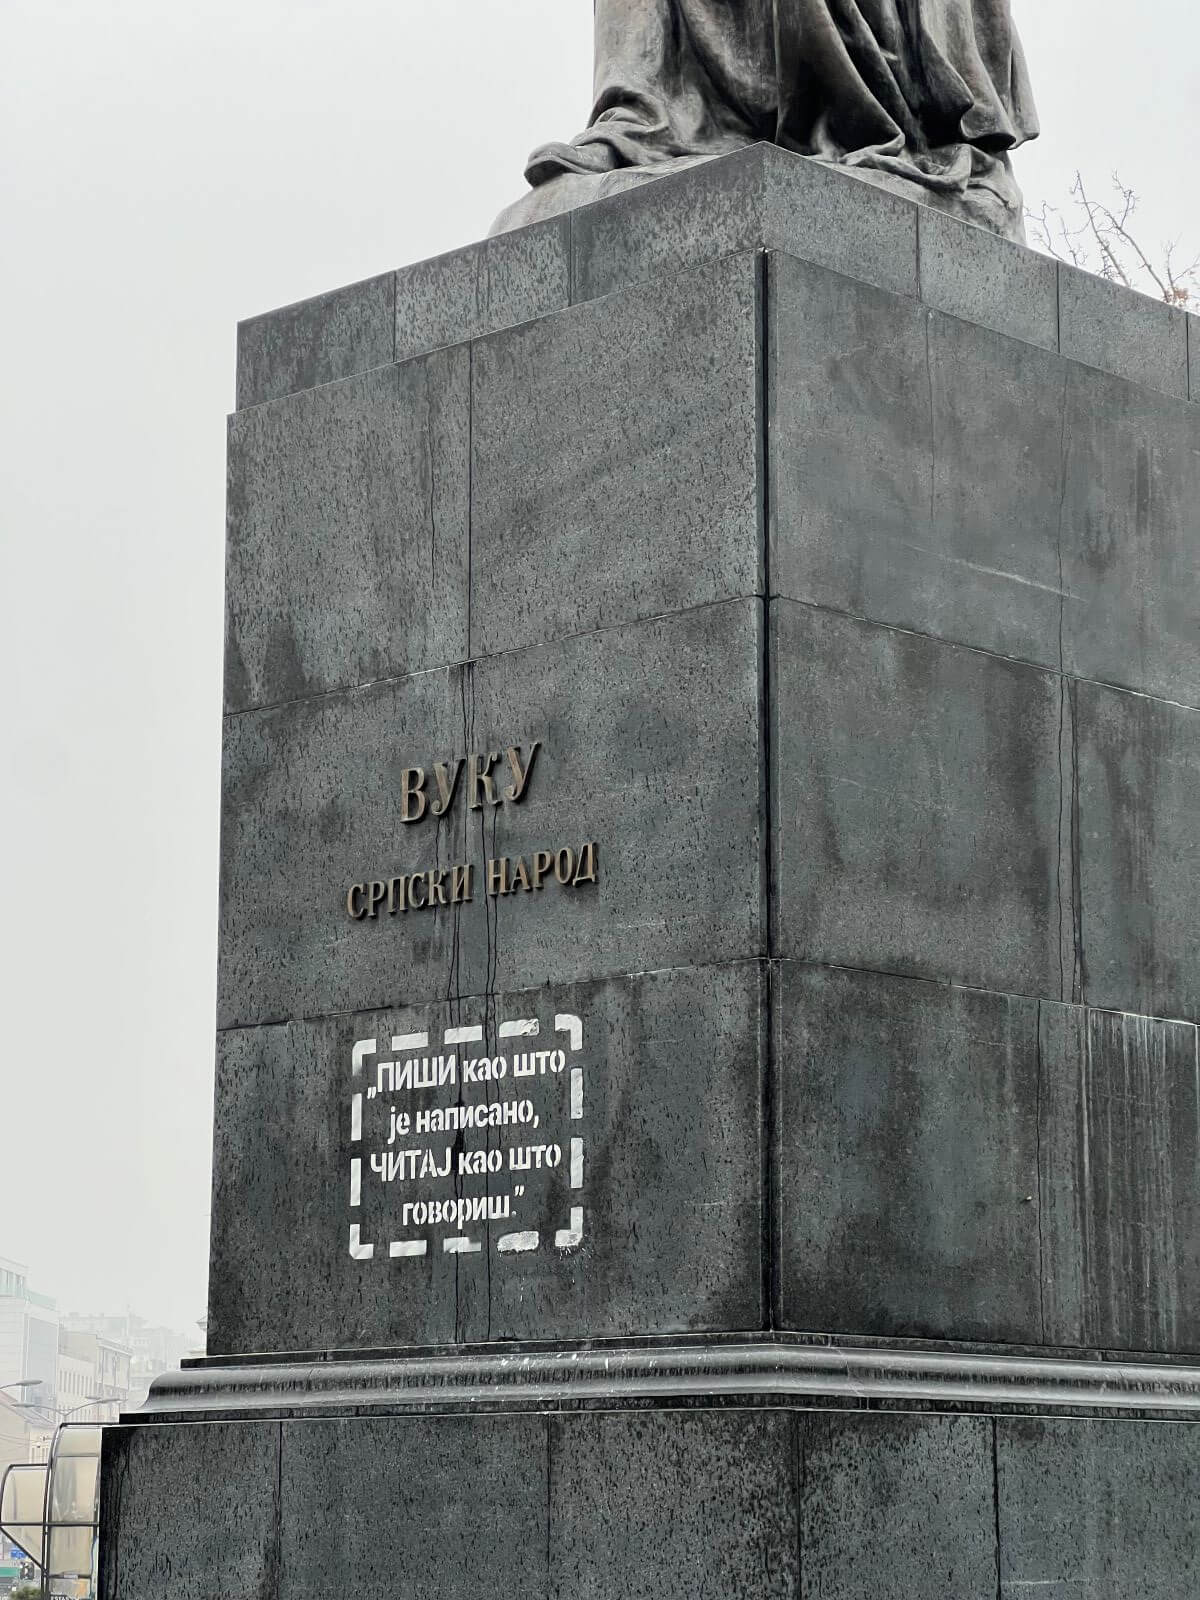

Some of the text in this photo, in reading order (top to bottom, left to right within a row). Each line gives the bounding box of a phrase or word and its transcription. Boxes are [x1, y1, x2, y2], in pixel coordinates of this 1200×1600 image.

[400, 742, 541, 823] ВУКУ
[347, 842, 598, 918] СРПСКИ НАРОД
[368, 1050, 566, 1099] „ПИШИ као што
[387, 1100, 539, 1144] је написано,
[371, 1144, 561, 1182] ЧИТАЈ као што
